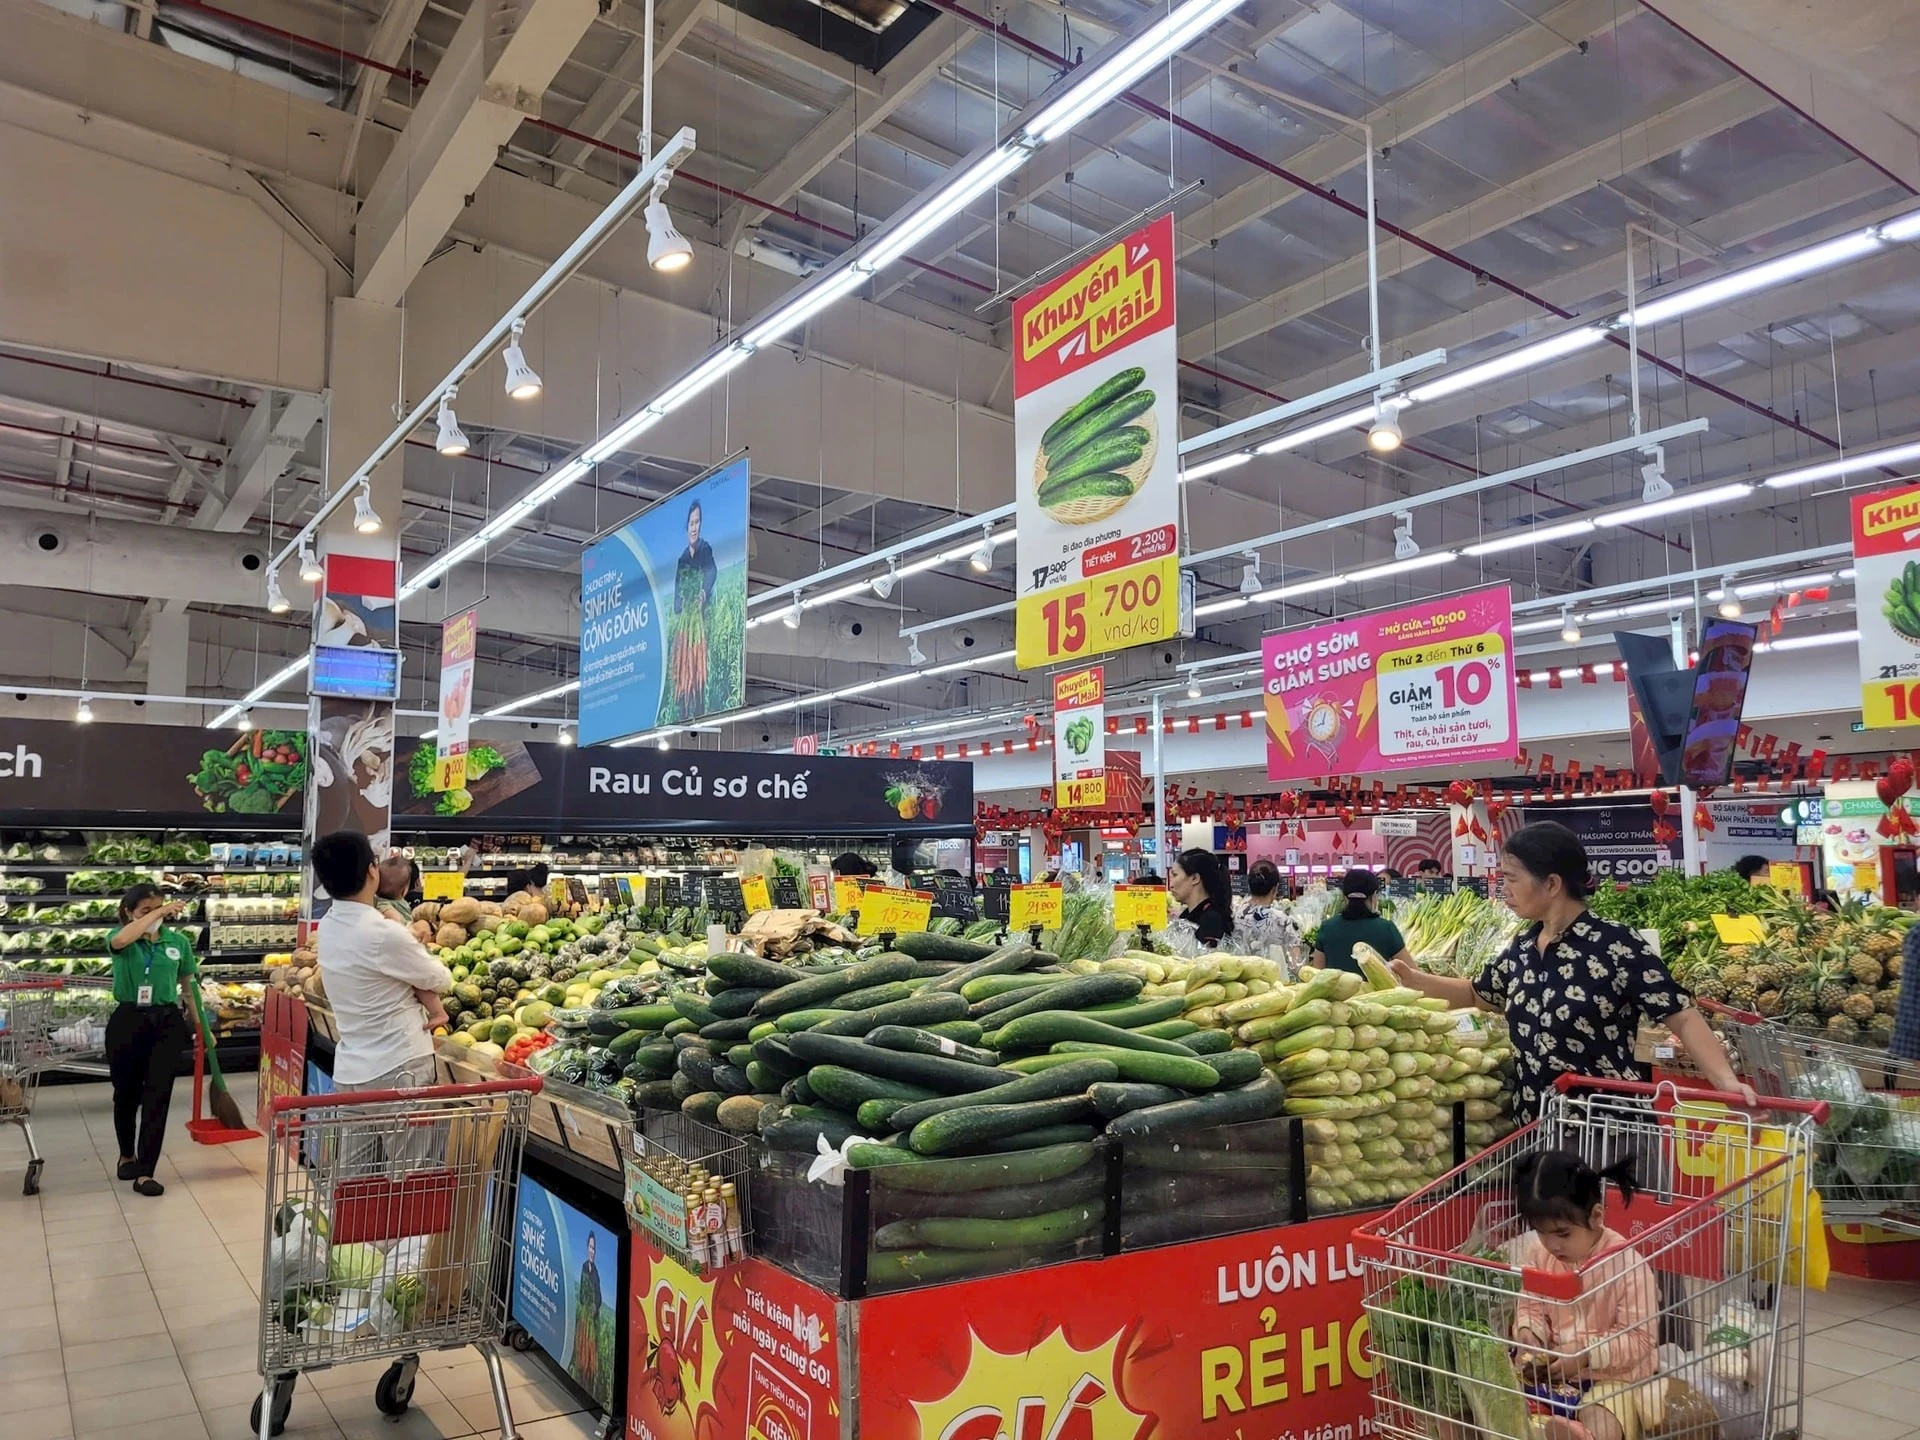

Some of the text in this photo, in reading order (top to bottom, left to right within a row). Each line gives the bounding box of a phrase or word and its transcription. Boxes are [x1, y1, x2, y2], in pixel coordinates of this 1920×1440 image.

[1027, 264, 1119, 348] Khuyến
[1096, 265, 1155, 346] Mãi!
[1867, 501, 1920, 529] Khu
[1071, 540, 1083, 551] đao
[1084, 536, 1095, 548] địa
[1095, 528, 1122, 544] phương
[1085, 551, 1117, 568] TIẾT KIỆM
[585, 572, 623, 622] SINH KẾ
[583, 602, 648, 654] CỘNG ĐỒNG
[1104, 615, 1159, 641] vnd/kg
[1384, 621, 1401, 636] MỞ
[1402, 618, 1423, 632] CỬA
[1430, 610, 1467, 627] 10:00
[1273, 631, 1360, 671] CHỢ SỚM
[1392, 642, 1485, 668] Thứ 2 đến Thứ 6
[1058, 675, 1089, 695] Khuyến
[1267, 653, 1372, 696] GIẢM SUNG
[1389, 657, 1501, 709] GIẢM 10 %
[1079, 682, 1099, 703] Mãi!
[1409, 702, 1433, 712] THÊM
[1411, 707, 1471, 723] Toàn bộ sản phẩm
[1394, 718, 1492, 741] Thịt, cá, hải sản tươi,
[1406, 732, 1479, 749] rau, củ, trái cây
[589, 765, 811, 799] Rau Củ sơ chế
[1067, 784, 1082, 805] 14
[938, 841, 961, 849] hoco.
[1581, 831, 1613, 840] HASUNO
[1614, 831, 1630, 839] GO!
[881, 888, 905, 897] KHUYẾN
[520, 1244, 540, 1276] CỘNG
[1218, 1245, 1318, 1304] LUÔN
[745, 1287, 793, 1332] Tiết kiệm
[654, 1279, 709, 1393] GIÁ
[732, 1311, 831, 1389] mỗi ngày cùng GO!
[1200, 1306, 1289, 1420] RẺ
